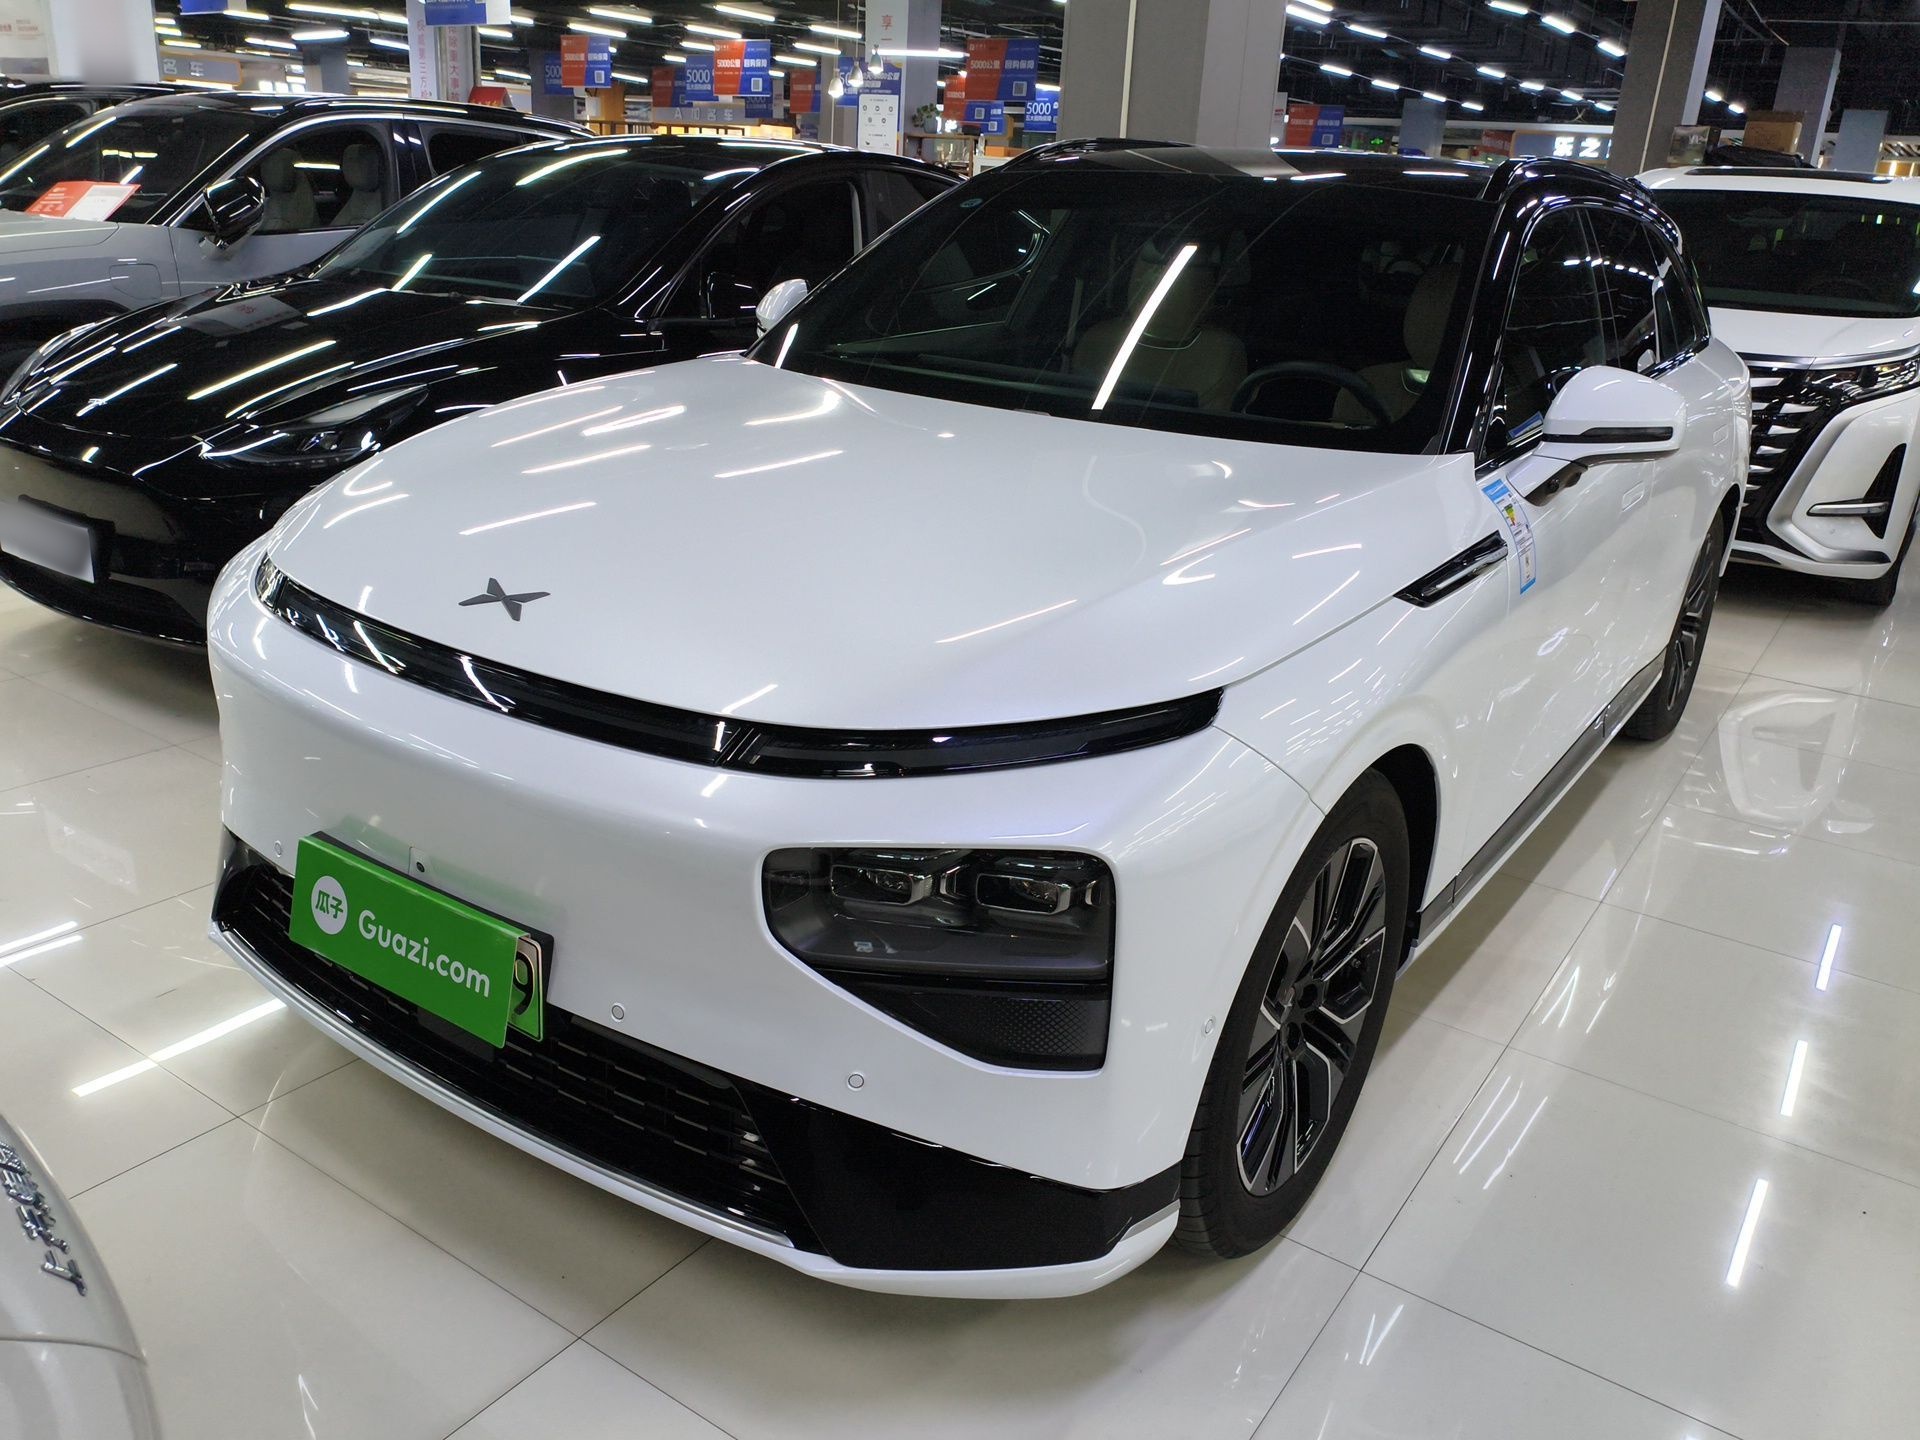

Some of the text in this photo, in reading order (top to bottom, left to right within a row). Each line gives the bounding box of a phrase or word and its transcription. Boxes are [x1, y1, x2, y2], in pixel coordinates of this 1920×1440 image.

[686, 69, 710, 83] 5000
[970, 60, 1001, 69] 5000公里
[1026, 102, 1051, 115] 5000
[1553, 136, 1612, 159] 乐之
[316, 889, 344, 919] 瓜子
[358, 909, 491, 998] Guazi.com
[513, 951, 534, 1016] 9
